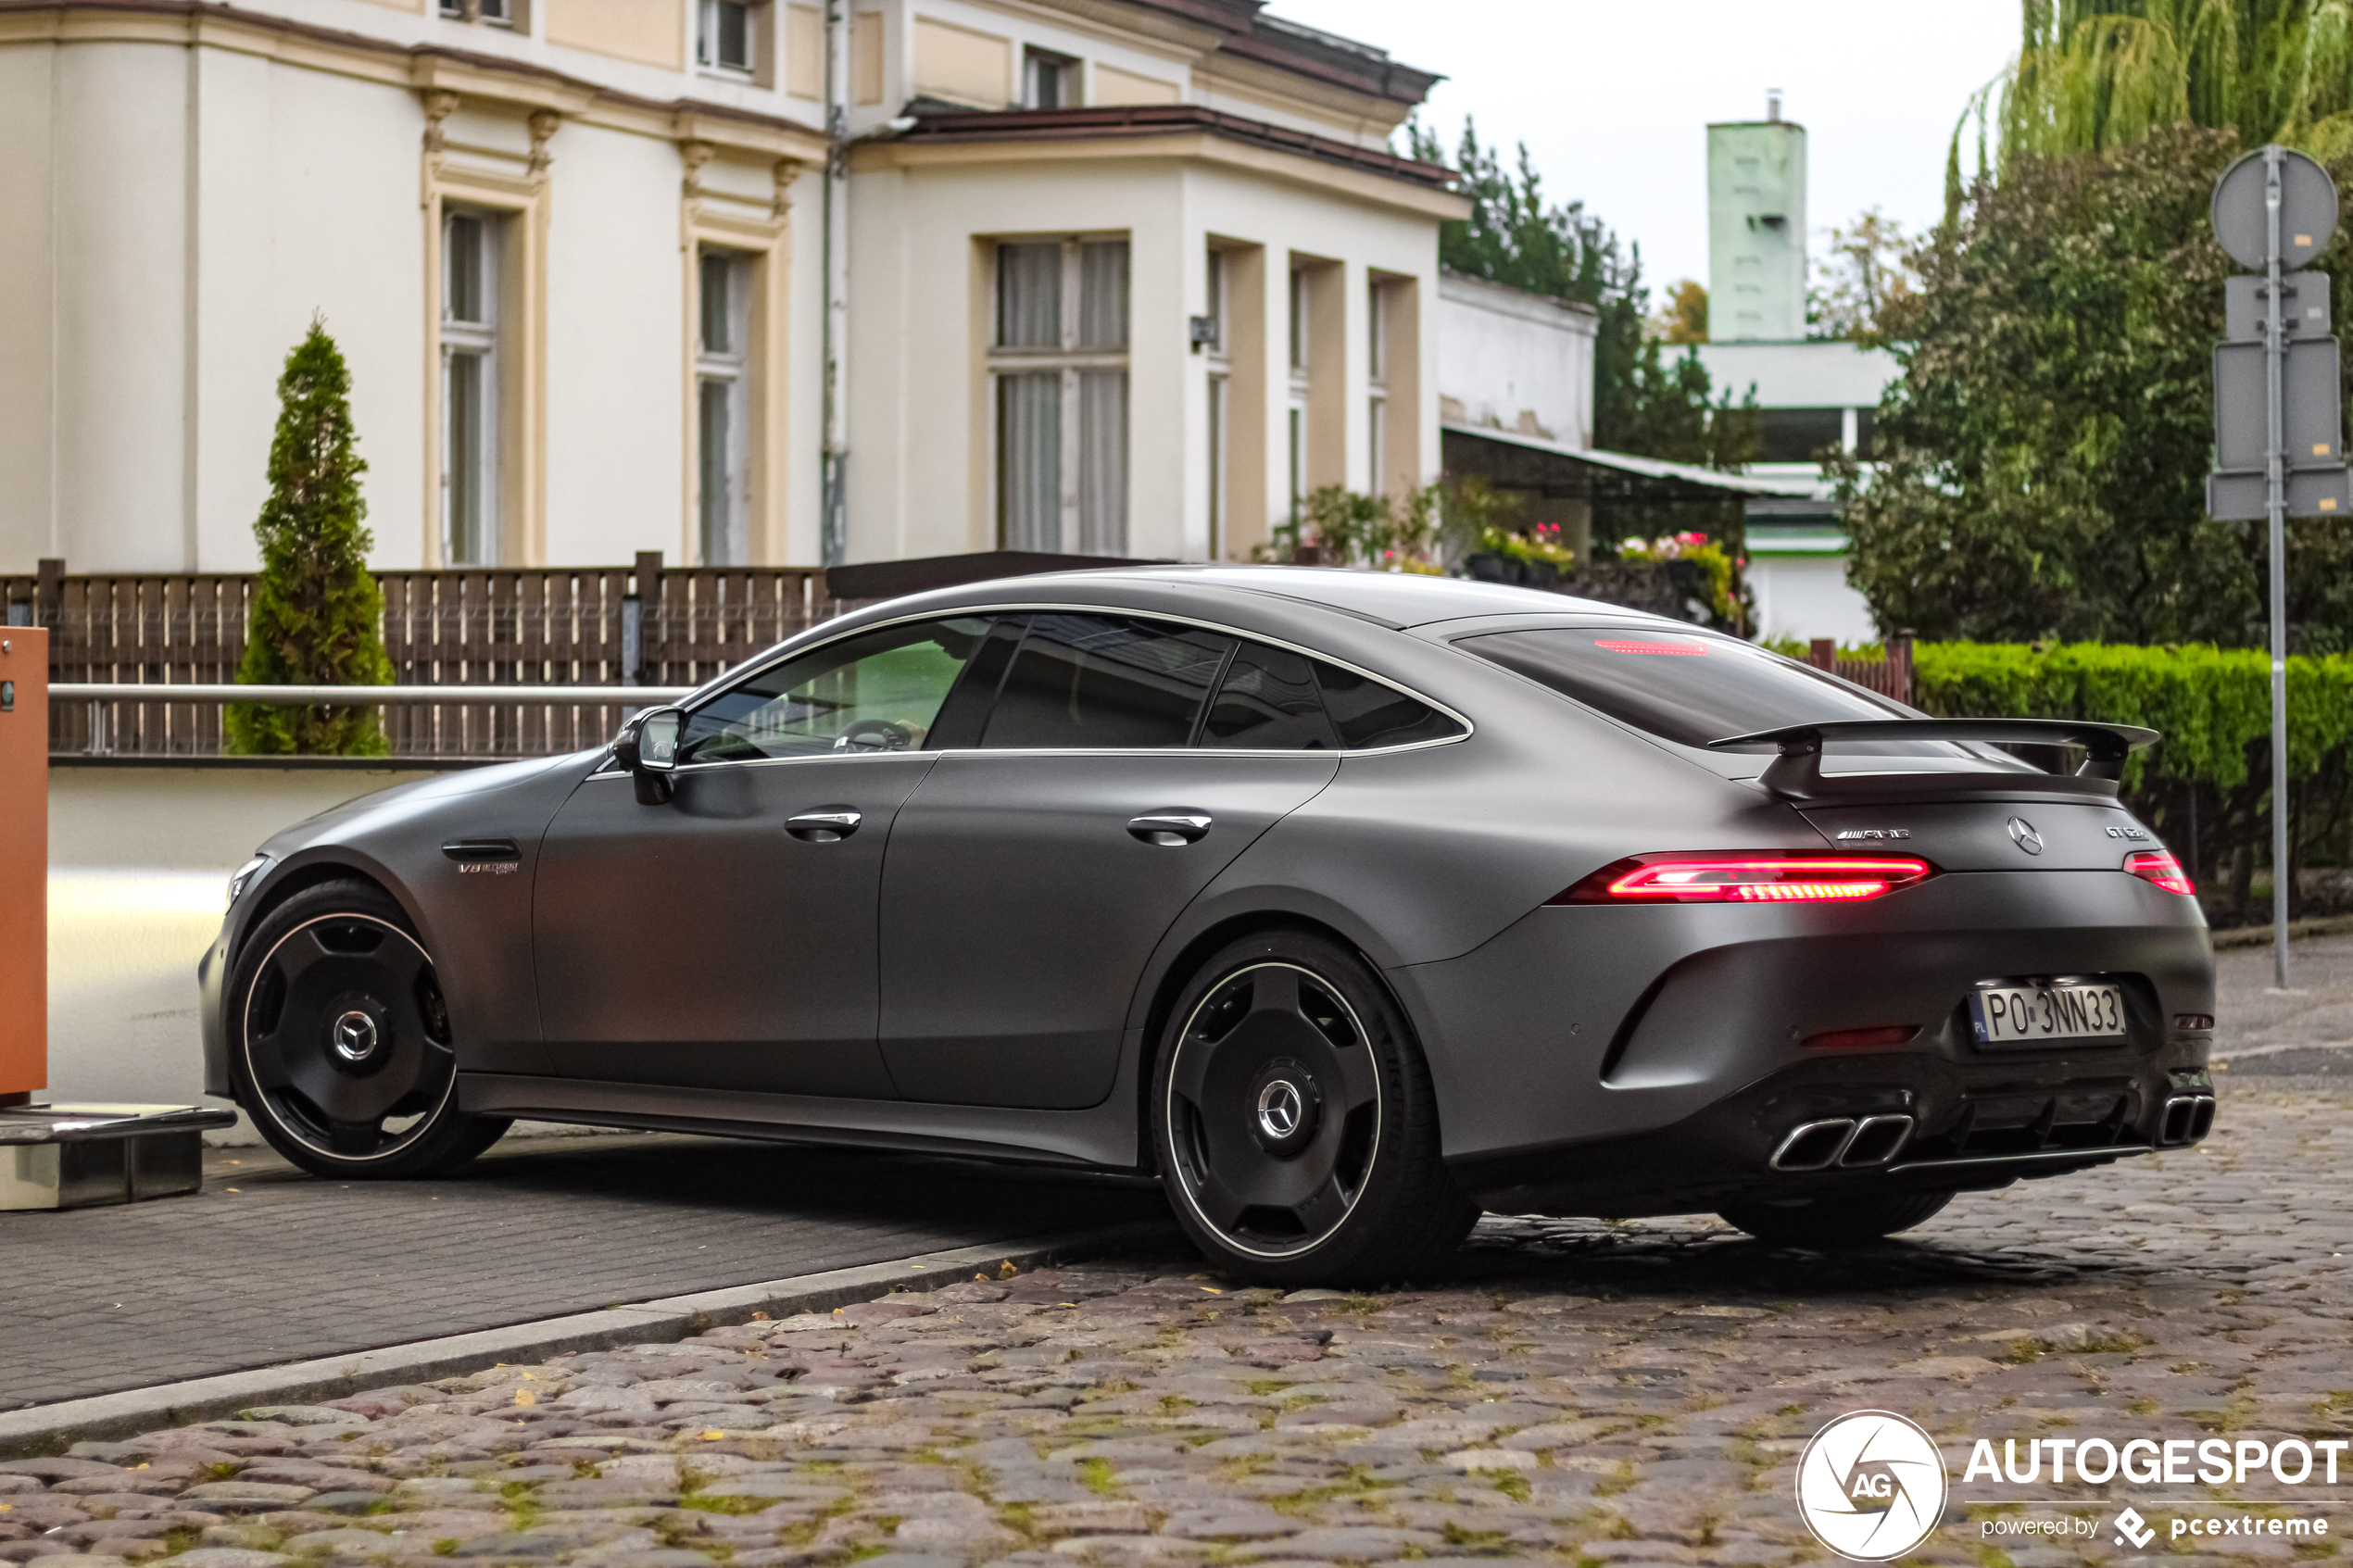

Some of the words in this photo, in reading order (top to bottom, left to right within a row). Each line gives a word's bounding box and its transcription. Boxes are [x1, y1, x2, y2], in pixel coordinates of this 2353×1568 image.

[458, 864, 481, 873] V8
[1987, 992, 2029, 1036] PO
[2036, 989, 2119, 1034] 3NN33
[1974, 1022, 1986, 1034] PL
